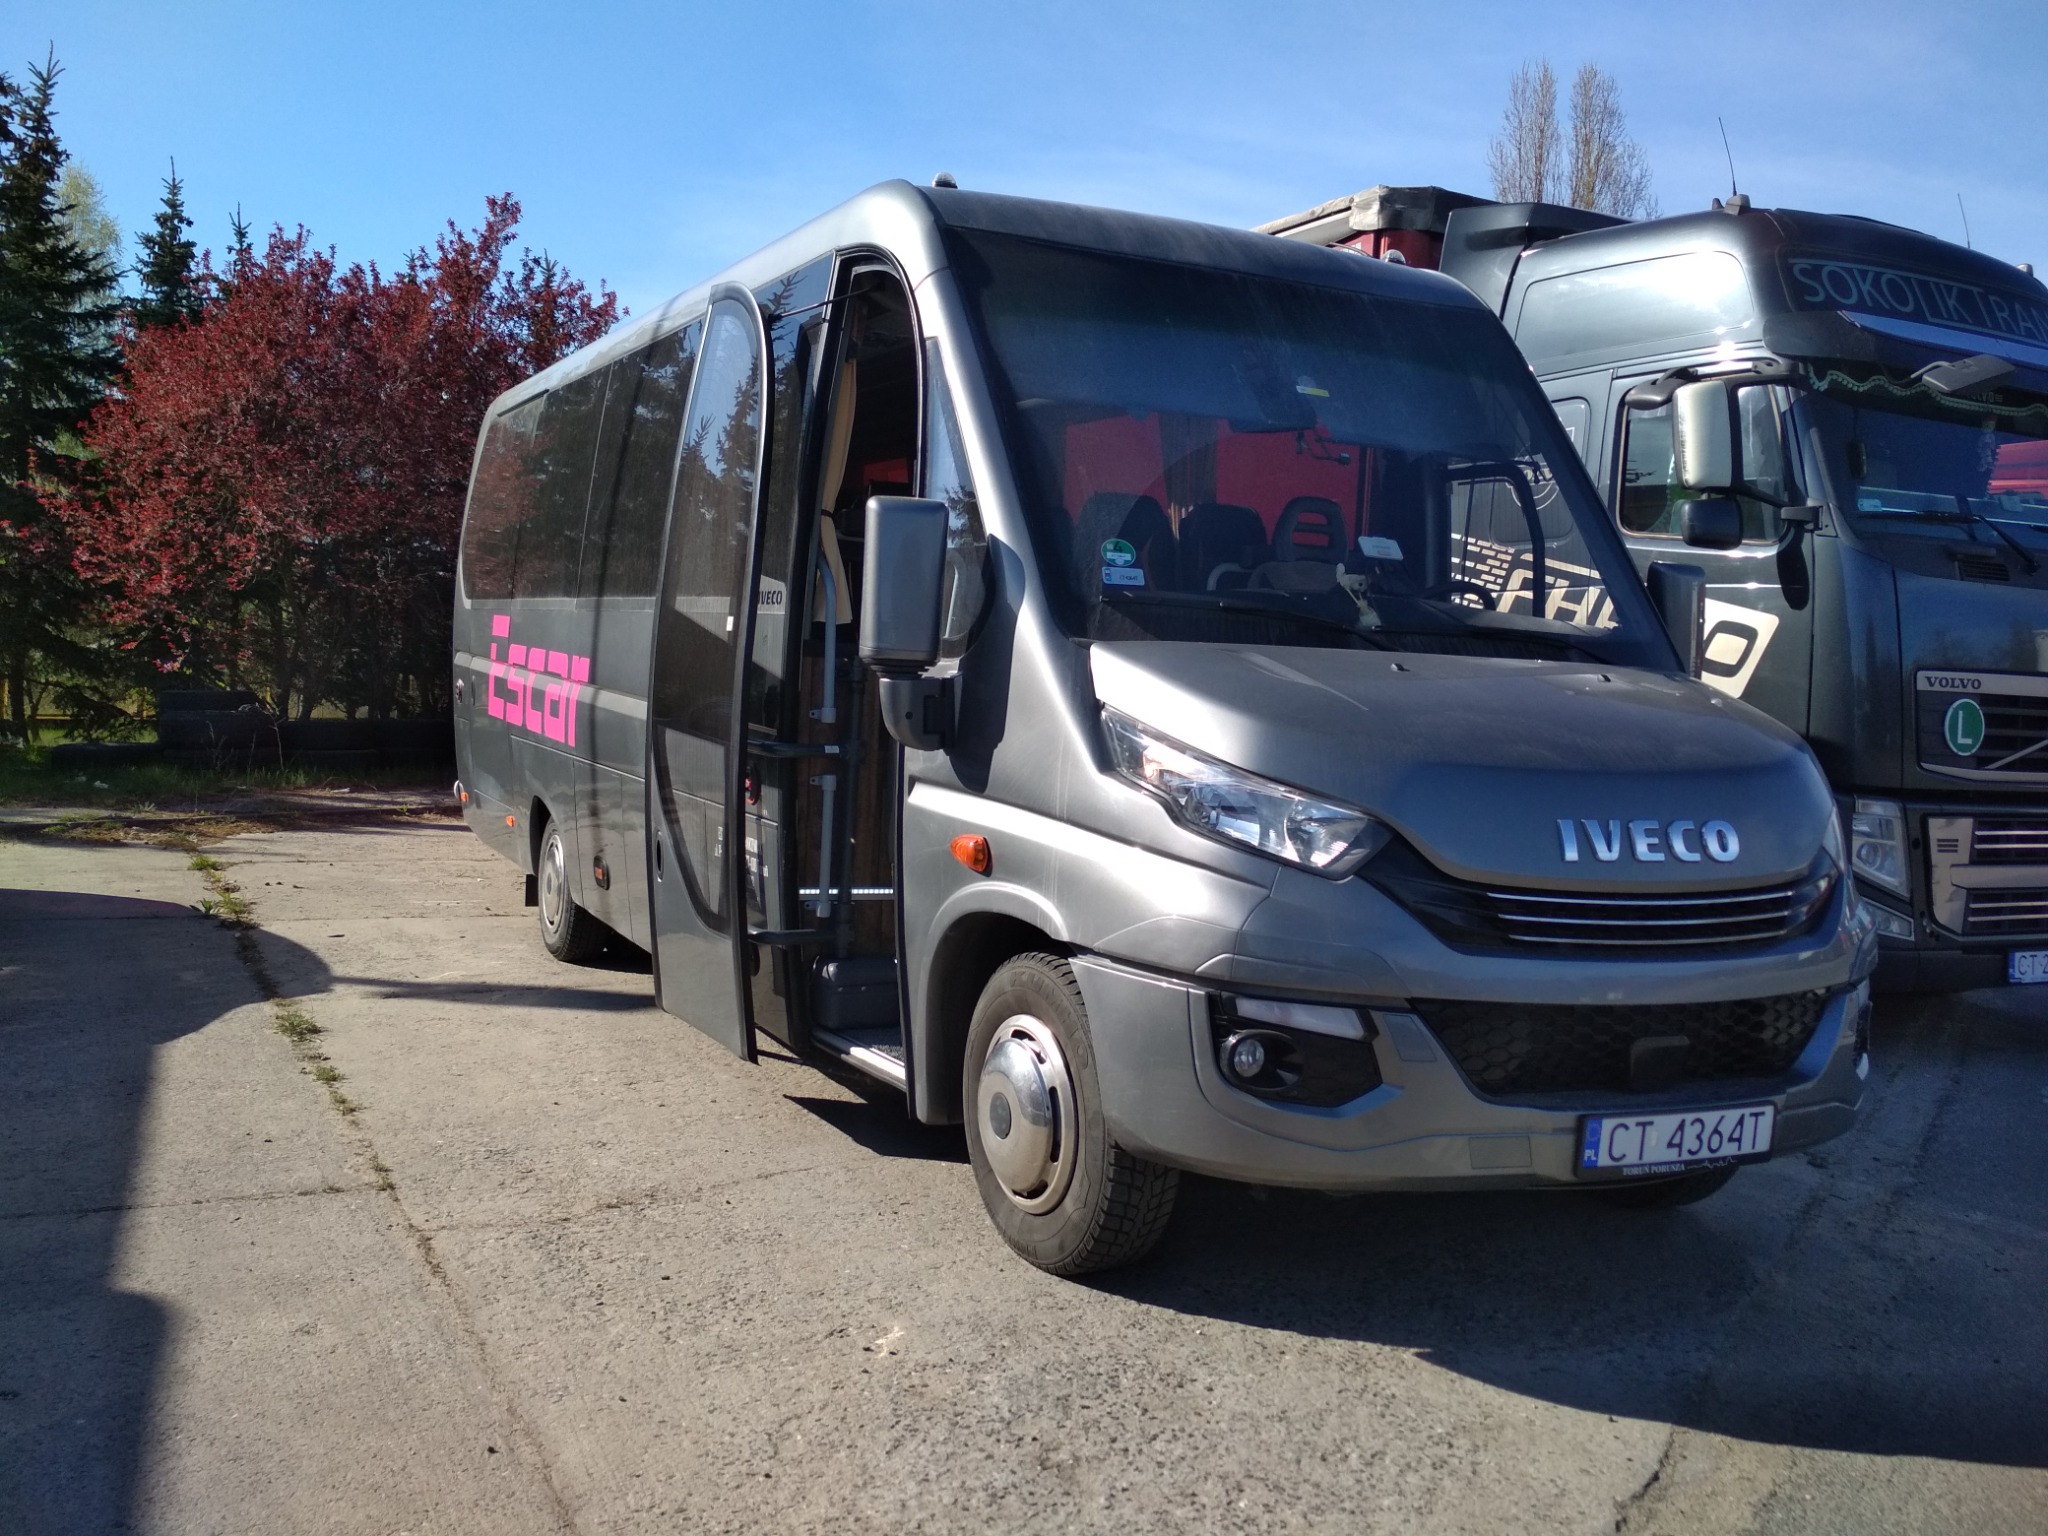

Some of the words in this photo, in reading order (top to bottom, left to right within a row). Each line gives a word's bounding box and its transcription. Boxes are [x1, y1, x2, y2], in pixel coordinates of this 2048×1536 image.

[1792, 263, 1972, 324] SOKOLIK
[488, 614, 590, 748] Escar
[1924, 675, 1982, 690] VOLVO
[1957, 709, 1973, 745] L
[1556, 818, 1740, 862] IVECO
[2018, 954, 2038, 976] CT
[1584, 1148, 1597, 1162] PL
[1608, 1121, 1654, 1162] CT
[1666, 1111, 1766, 1158] 4364T
